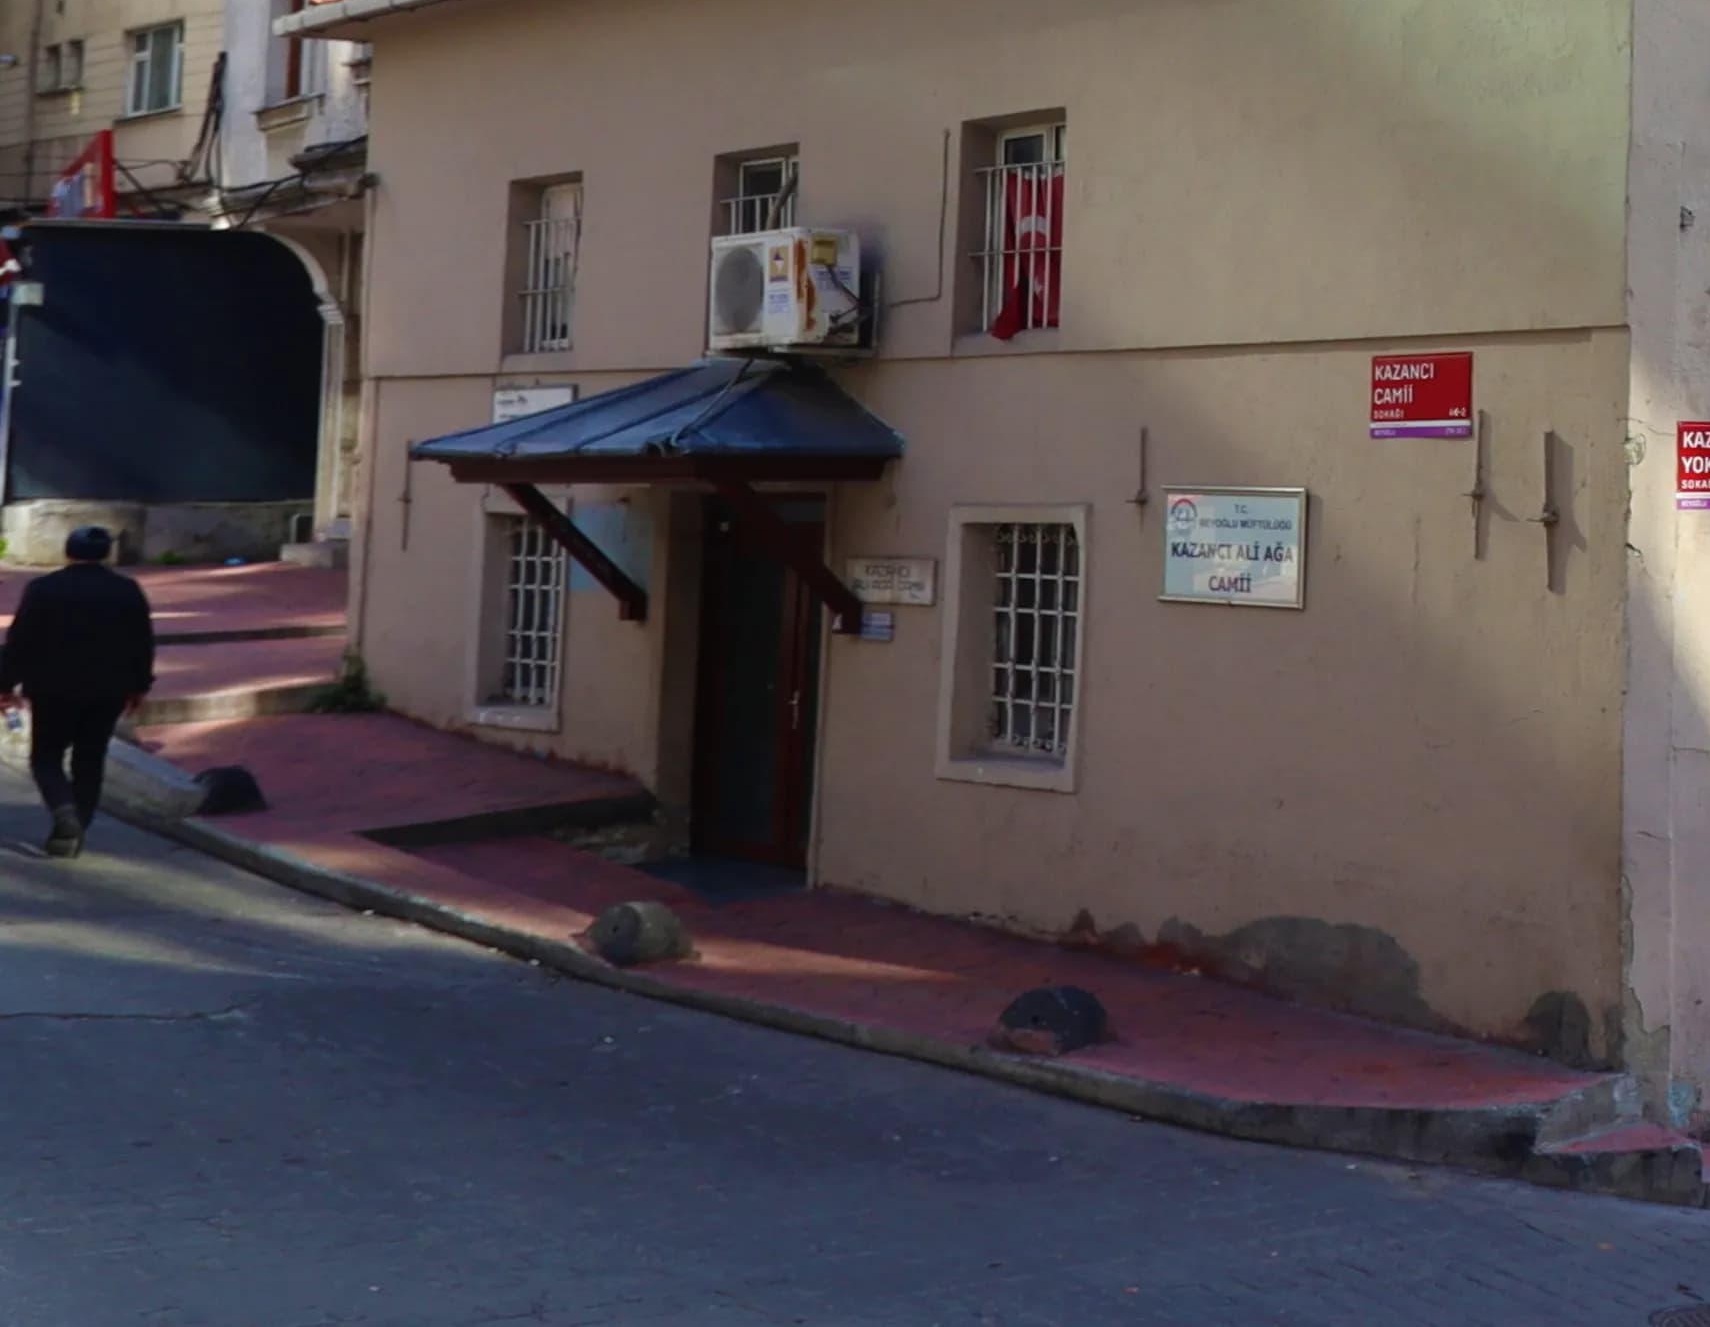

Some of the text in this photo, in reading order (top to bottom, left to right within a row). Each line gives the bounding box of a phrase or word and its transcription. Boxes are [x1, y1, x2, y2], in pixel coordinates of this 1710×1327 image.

[1375, 363, 1434, 380] KAZANCI
[1374, 385, 1413, 405] CAMİİ
[1171, 541, 1293, 562] KAZANCI ALİ AĞA
[1208, 573, 1252, 593] CAMİİ
